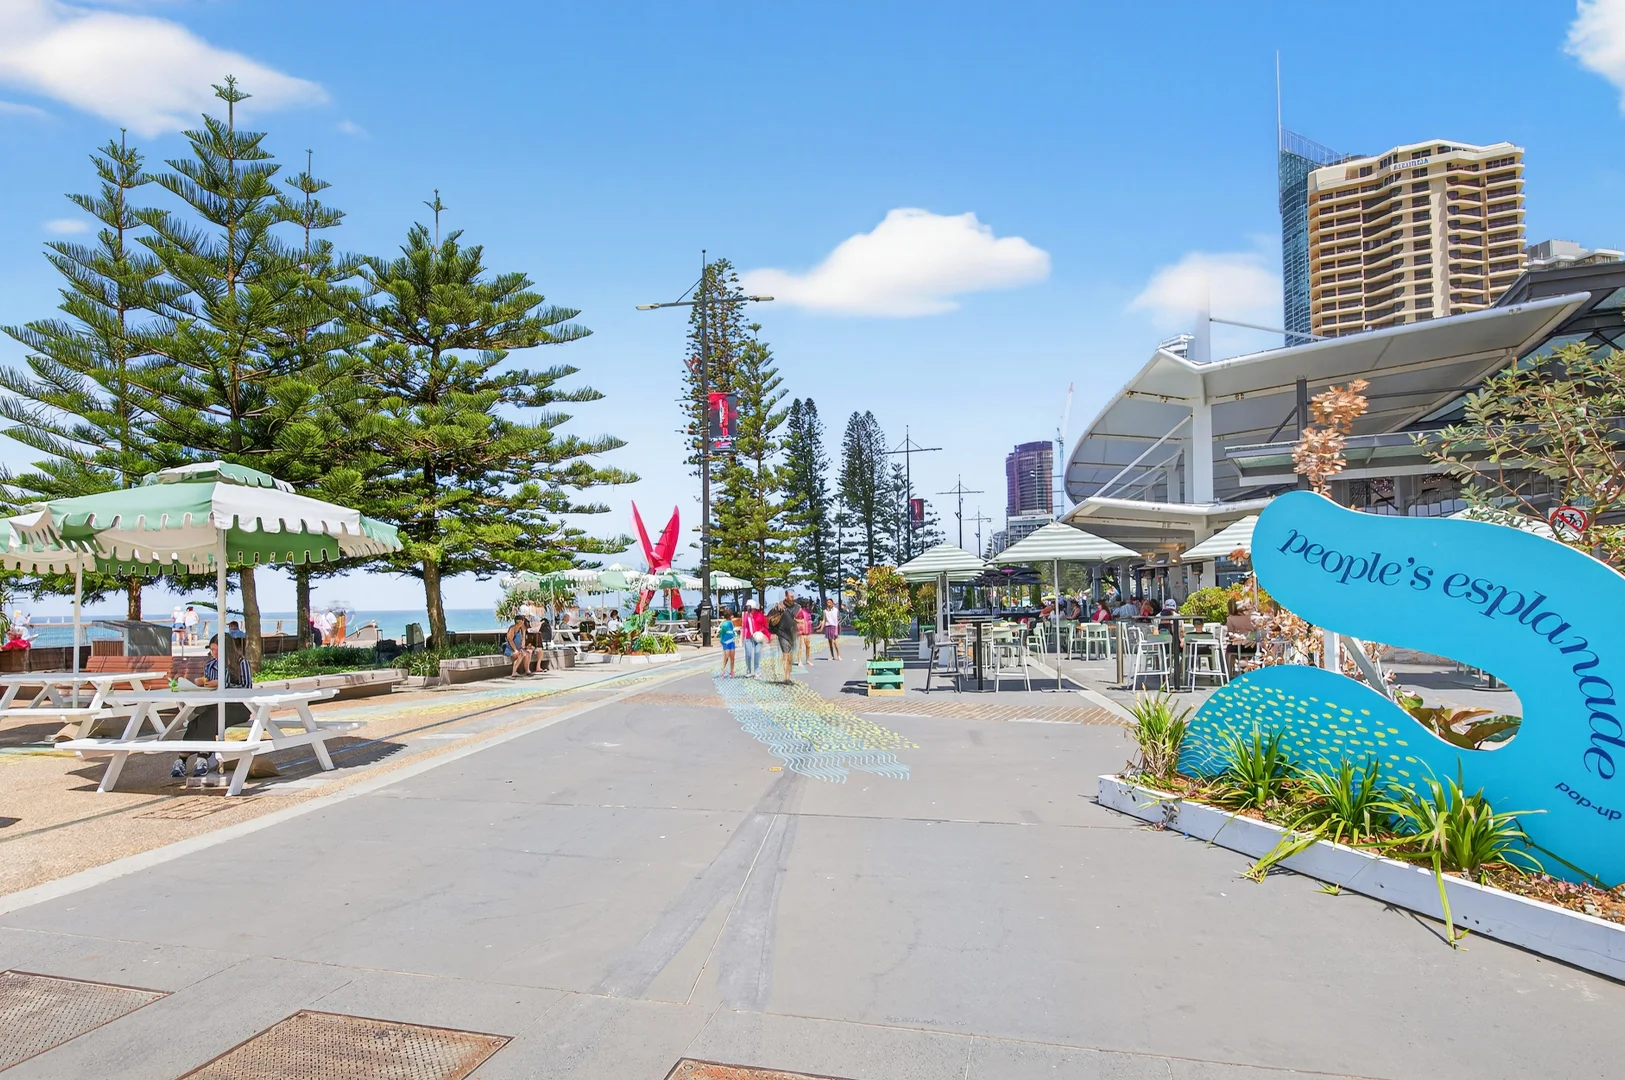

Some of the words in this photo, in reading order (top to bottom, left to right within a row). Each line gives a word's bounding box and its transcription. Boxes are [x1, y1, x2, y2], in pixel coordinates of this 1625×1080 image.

[1276, 528, 1434, 591] people's
[1442, 572, 1625, 780] esplanade
[1554, 781, 1623, 821] pop-up
